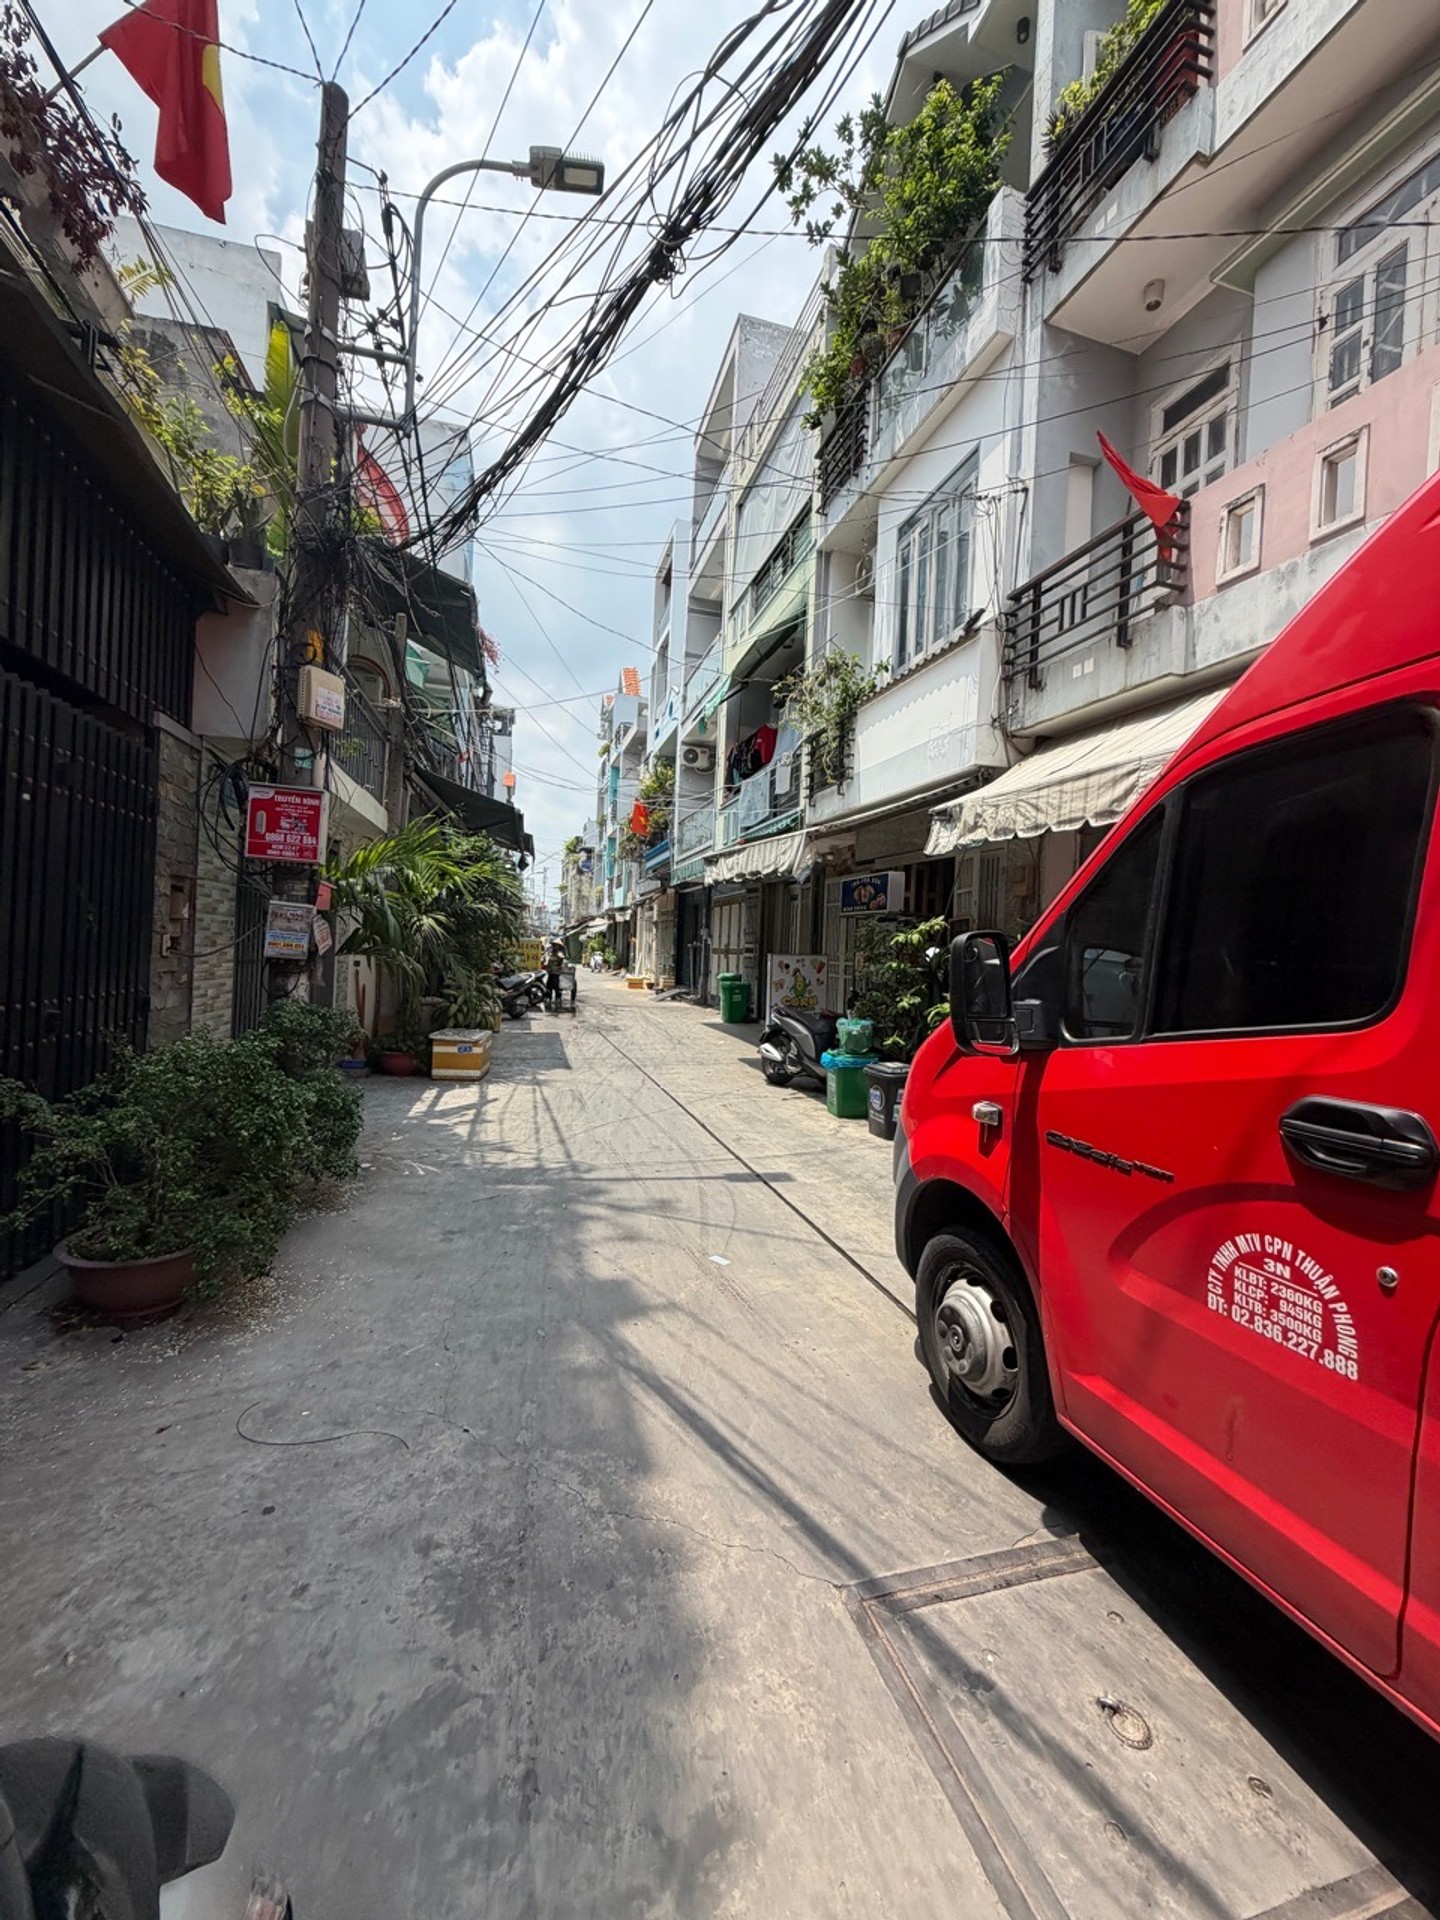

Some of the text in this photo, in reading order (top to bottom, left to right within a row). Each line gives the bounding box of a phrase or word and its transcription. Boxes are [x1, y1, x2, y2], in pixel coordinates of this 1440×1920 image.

[1212, 1240, 1240, 1272] TNHH
[1234, 1233, 1262, 1253] MTV
[1264, 1234, 1293, 1261] CPN
[1207, 1268, 1224, 1295] CTY
[1234, 1265, 1268, 1291] KLBT:
[1263, 1258, 1292, 1280] 3N
[1234, 1279, 1323, 1328] KLCP: 945KG
[1234, 1292, 1322, 1343] KLTB: 3500KG
[1207, 1293, 1359, 1381] ĐT: 02.836.227.888
[1329, 1302, 1359, 1359] PHONG
